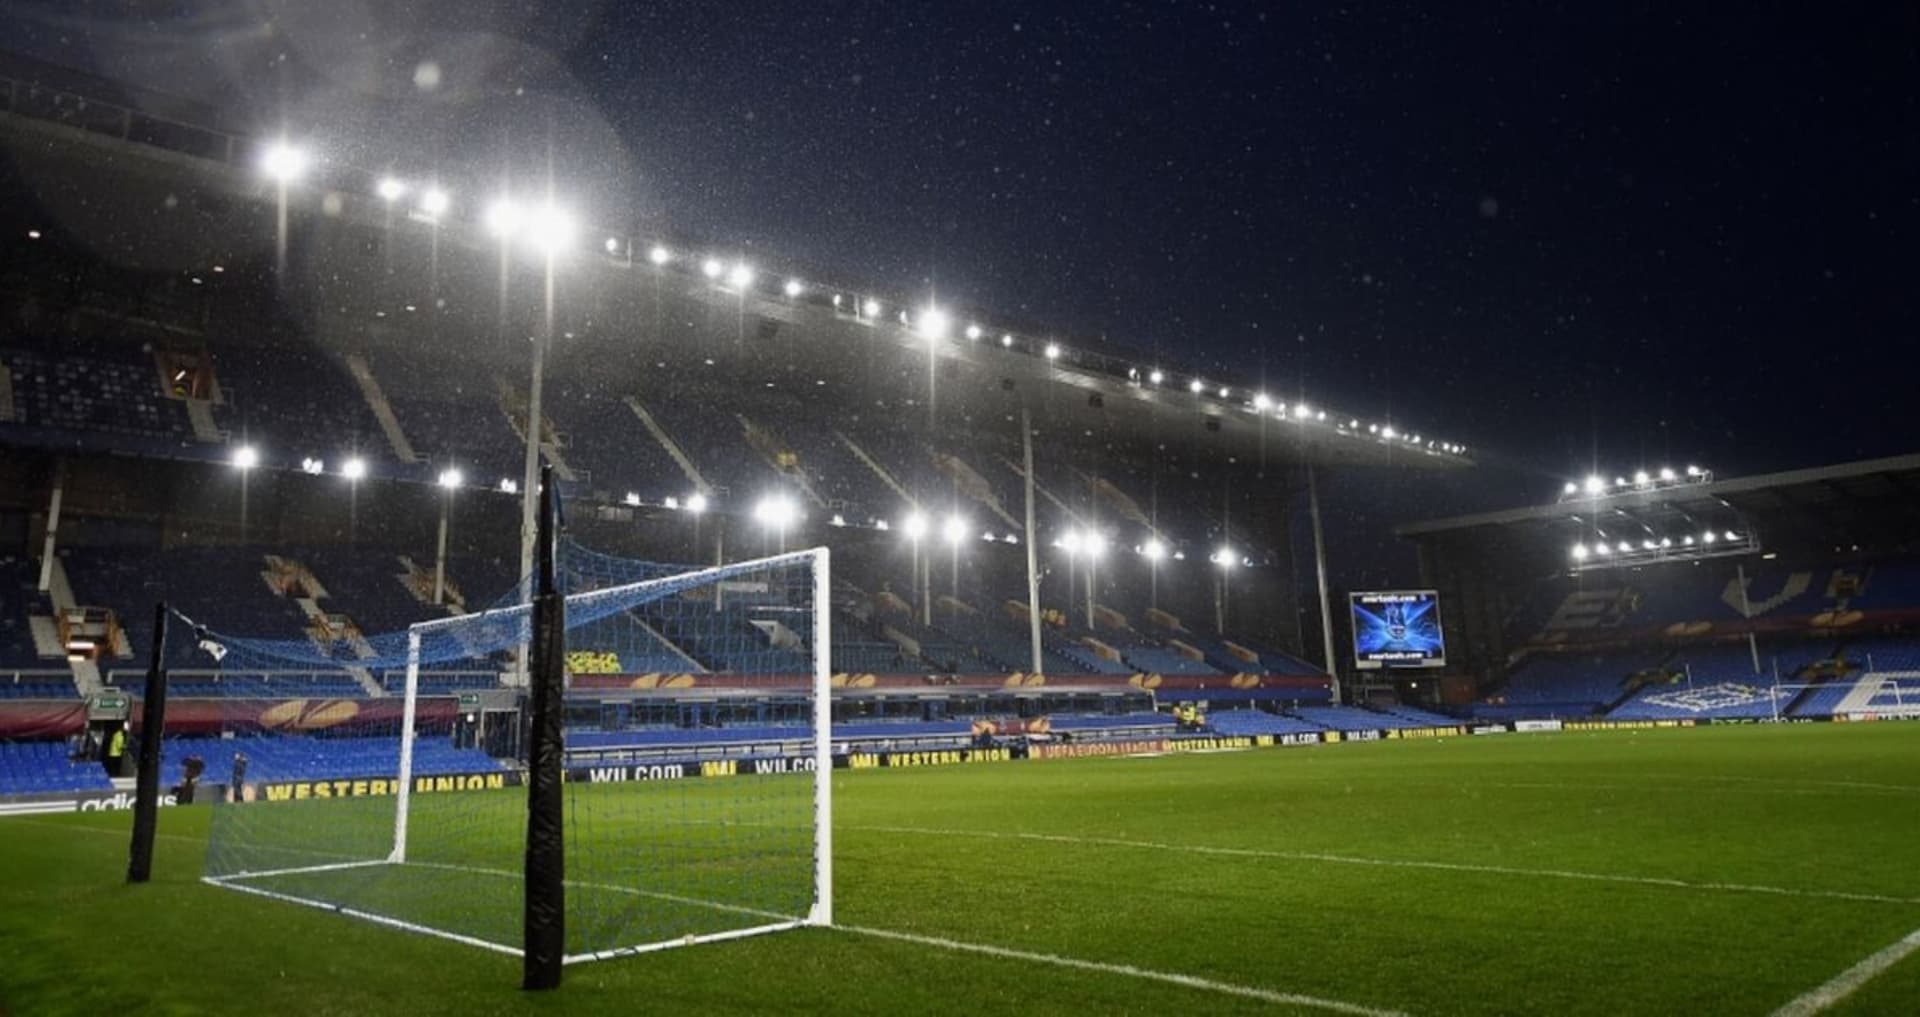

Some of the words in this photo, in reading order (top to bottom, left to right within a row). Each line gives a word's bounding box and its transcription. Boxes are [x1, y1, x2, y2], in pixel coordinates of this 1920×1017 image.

[888, 750, 961, 767] WESTERN
[1046, 743, 1076, 759] UEFA
[1078, 742, 1118, 757] EUROPA
[416, 774, 504, 793] UNION
